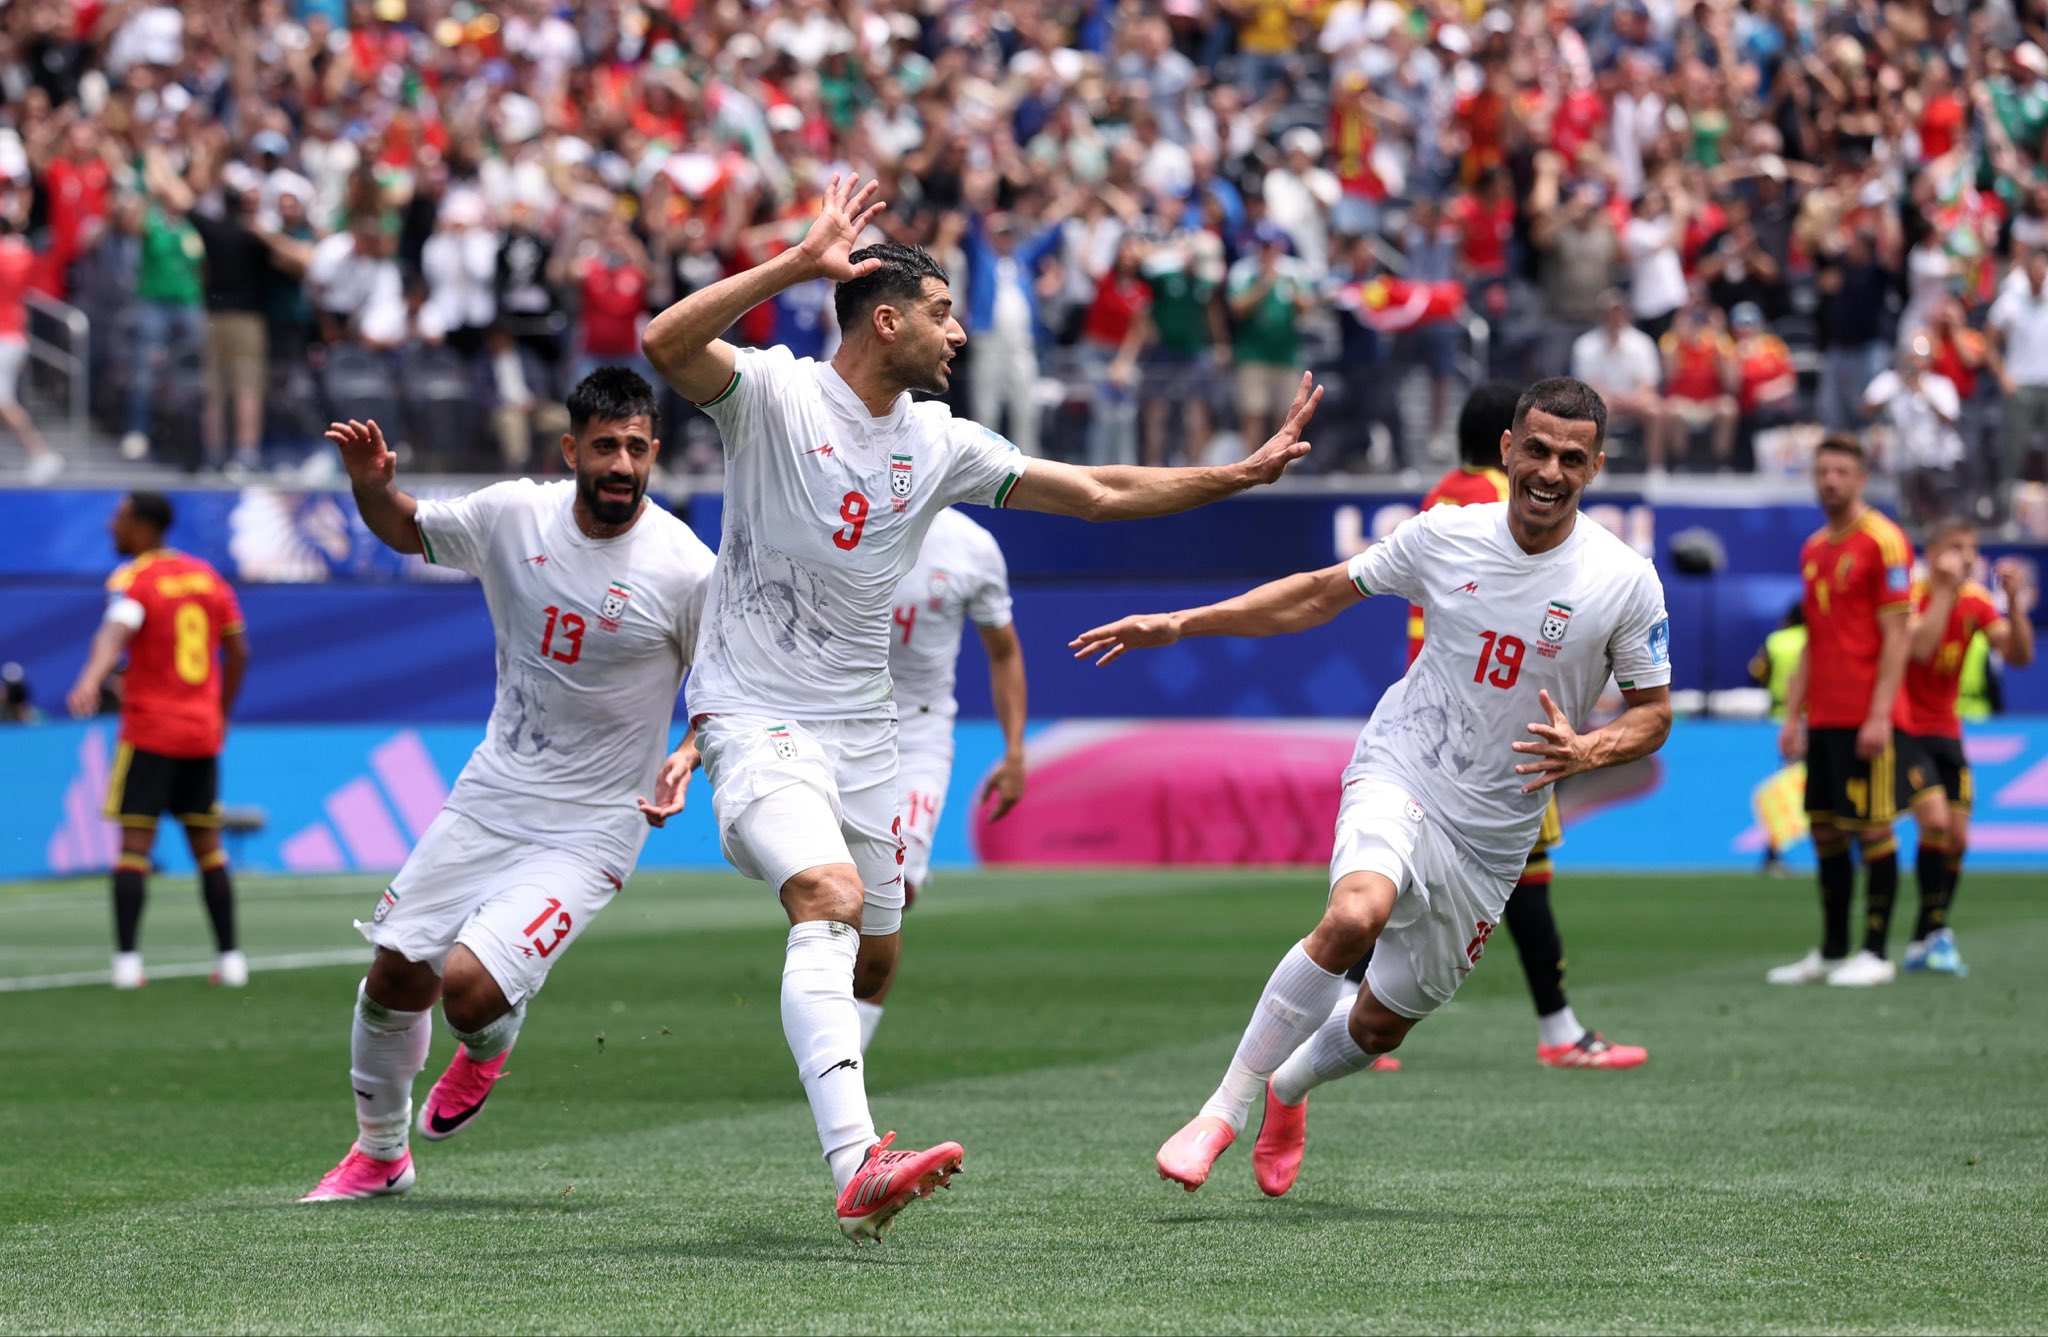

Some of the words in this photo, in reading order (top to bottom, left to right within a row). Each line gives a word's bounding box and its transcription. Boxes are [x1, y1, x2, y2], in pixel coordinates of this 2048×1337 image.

[832, 491, 869, 551] 9
[175, 603, 209, 684] 8
[541, 606, 585, 665] 13
[895, 604, 916, 646] 4
[1474, 630, 1526, 690] 19
[908, 791, 938, 834] 14
[523, 898, 572, 958] 13
